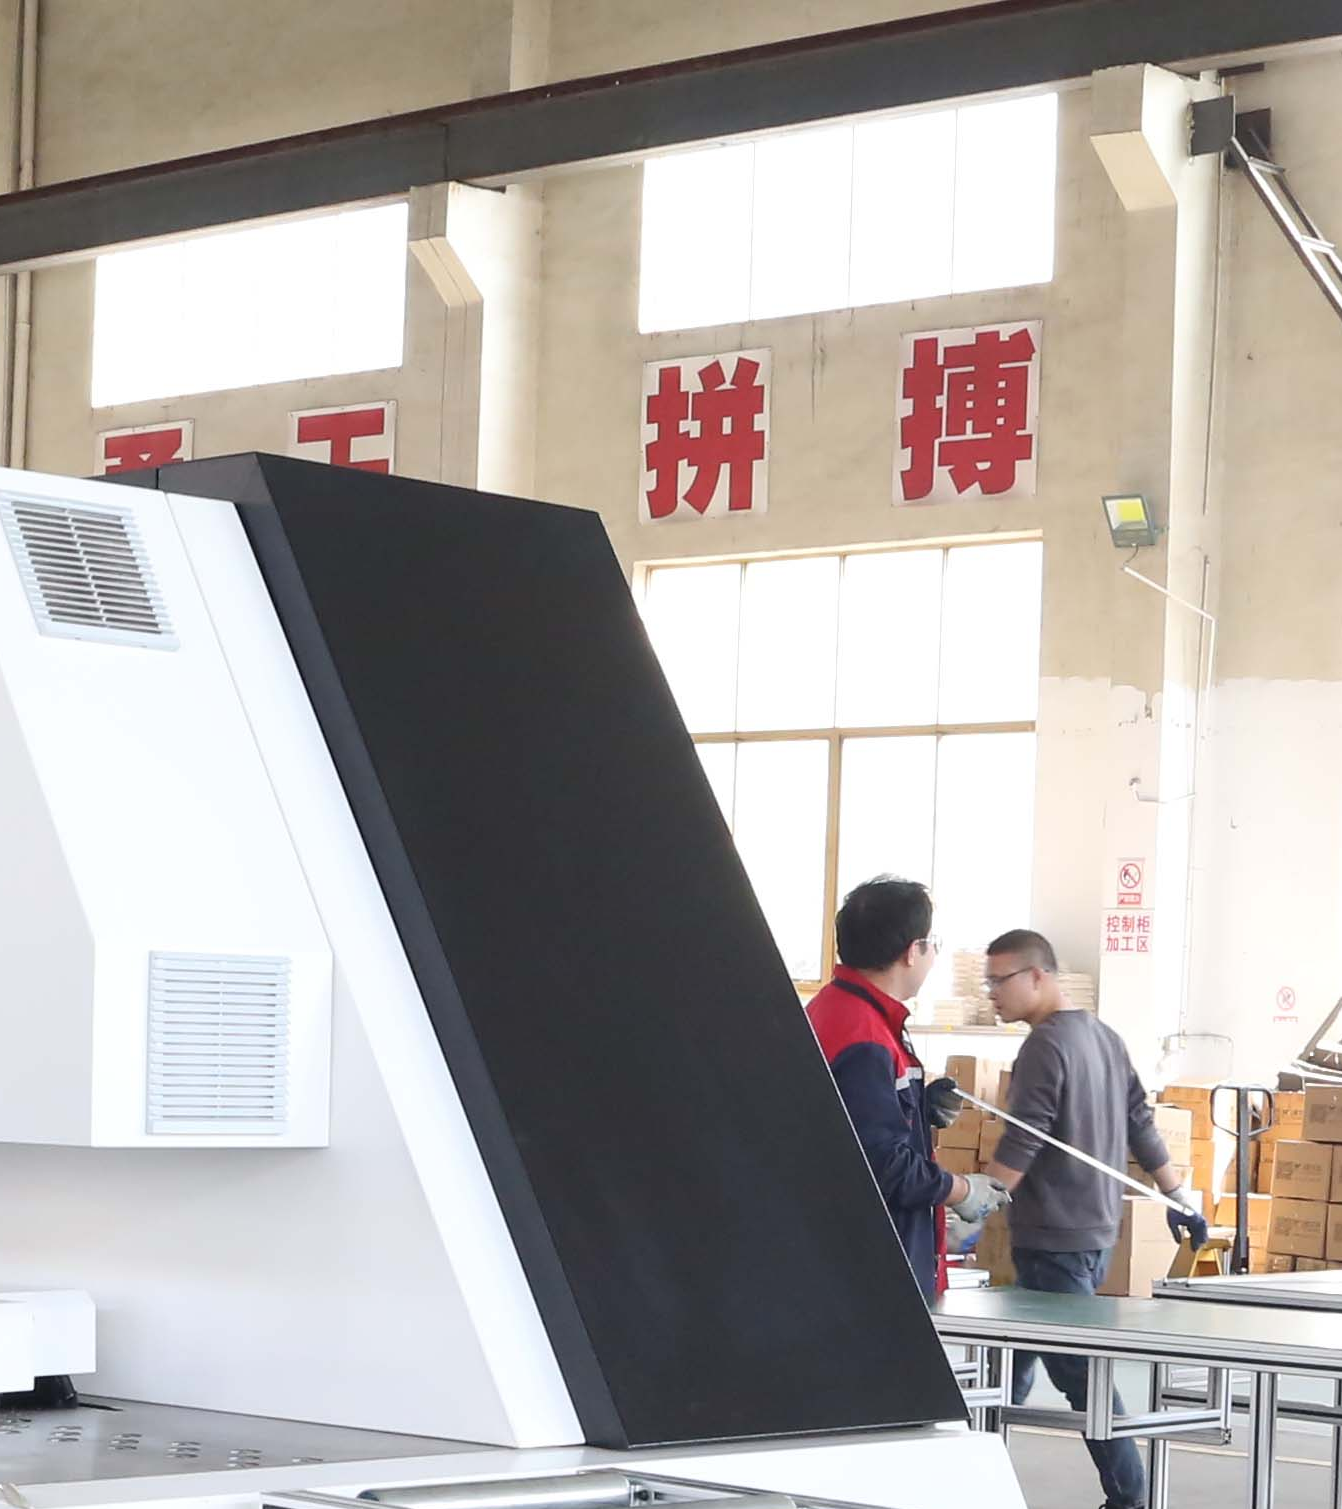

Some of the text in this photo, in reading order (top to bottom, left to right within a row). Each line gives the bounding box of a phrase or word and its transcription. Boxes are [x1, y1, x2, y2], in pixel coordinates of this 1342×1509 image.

[645, 328, 1036, 519] 拼搏
[1106, 914, 1152, 934] 控制柜
[1105, 934, 1149, 953] 加工区
